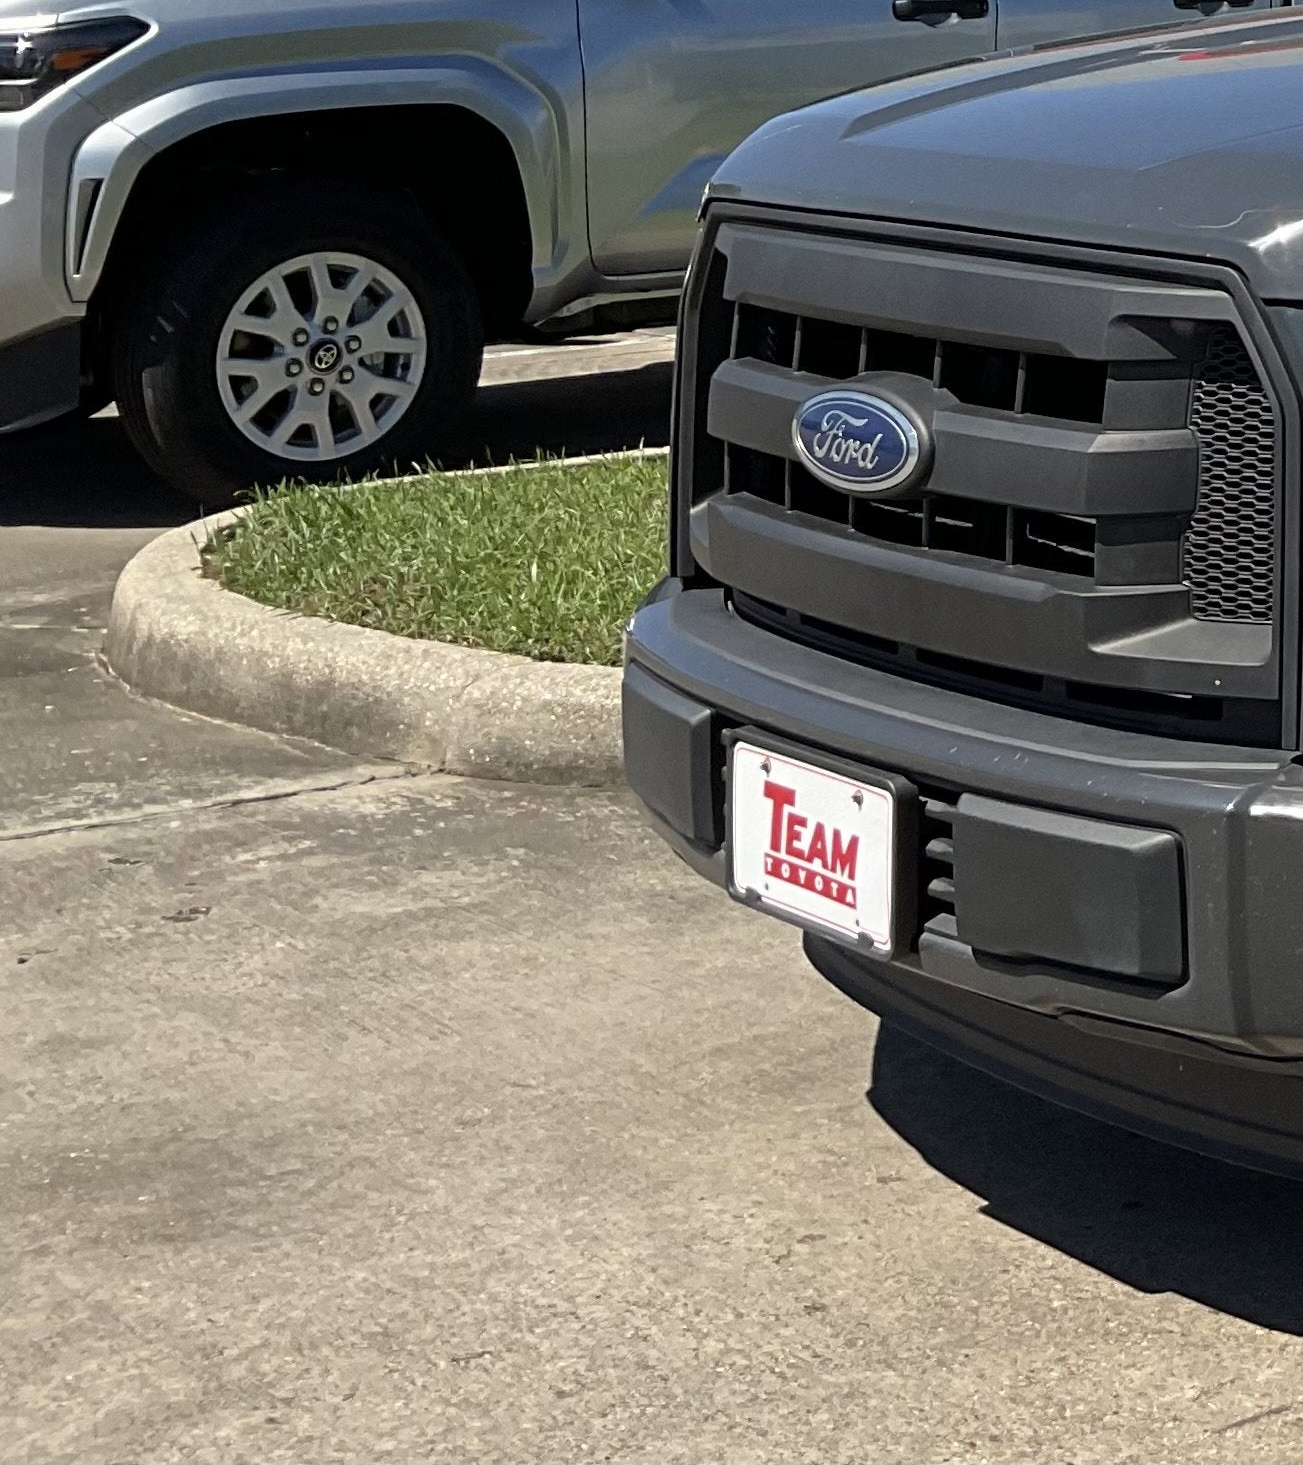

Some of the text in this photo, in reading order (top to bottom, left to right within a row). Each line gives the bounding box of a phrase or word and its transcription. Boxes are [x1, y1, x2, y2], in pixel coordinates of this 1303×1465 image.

[813, 409, 883, 470] Ford
[763, 779, 860, 881] TEAM
[764, 855, 857, 906] TOYOTA
